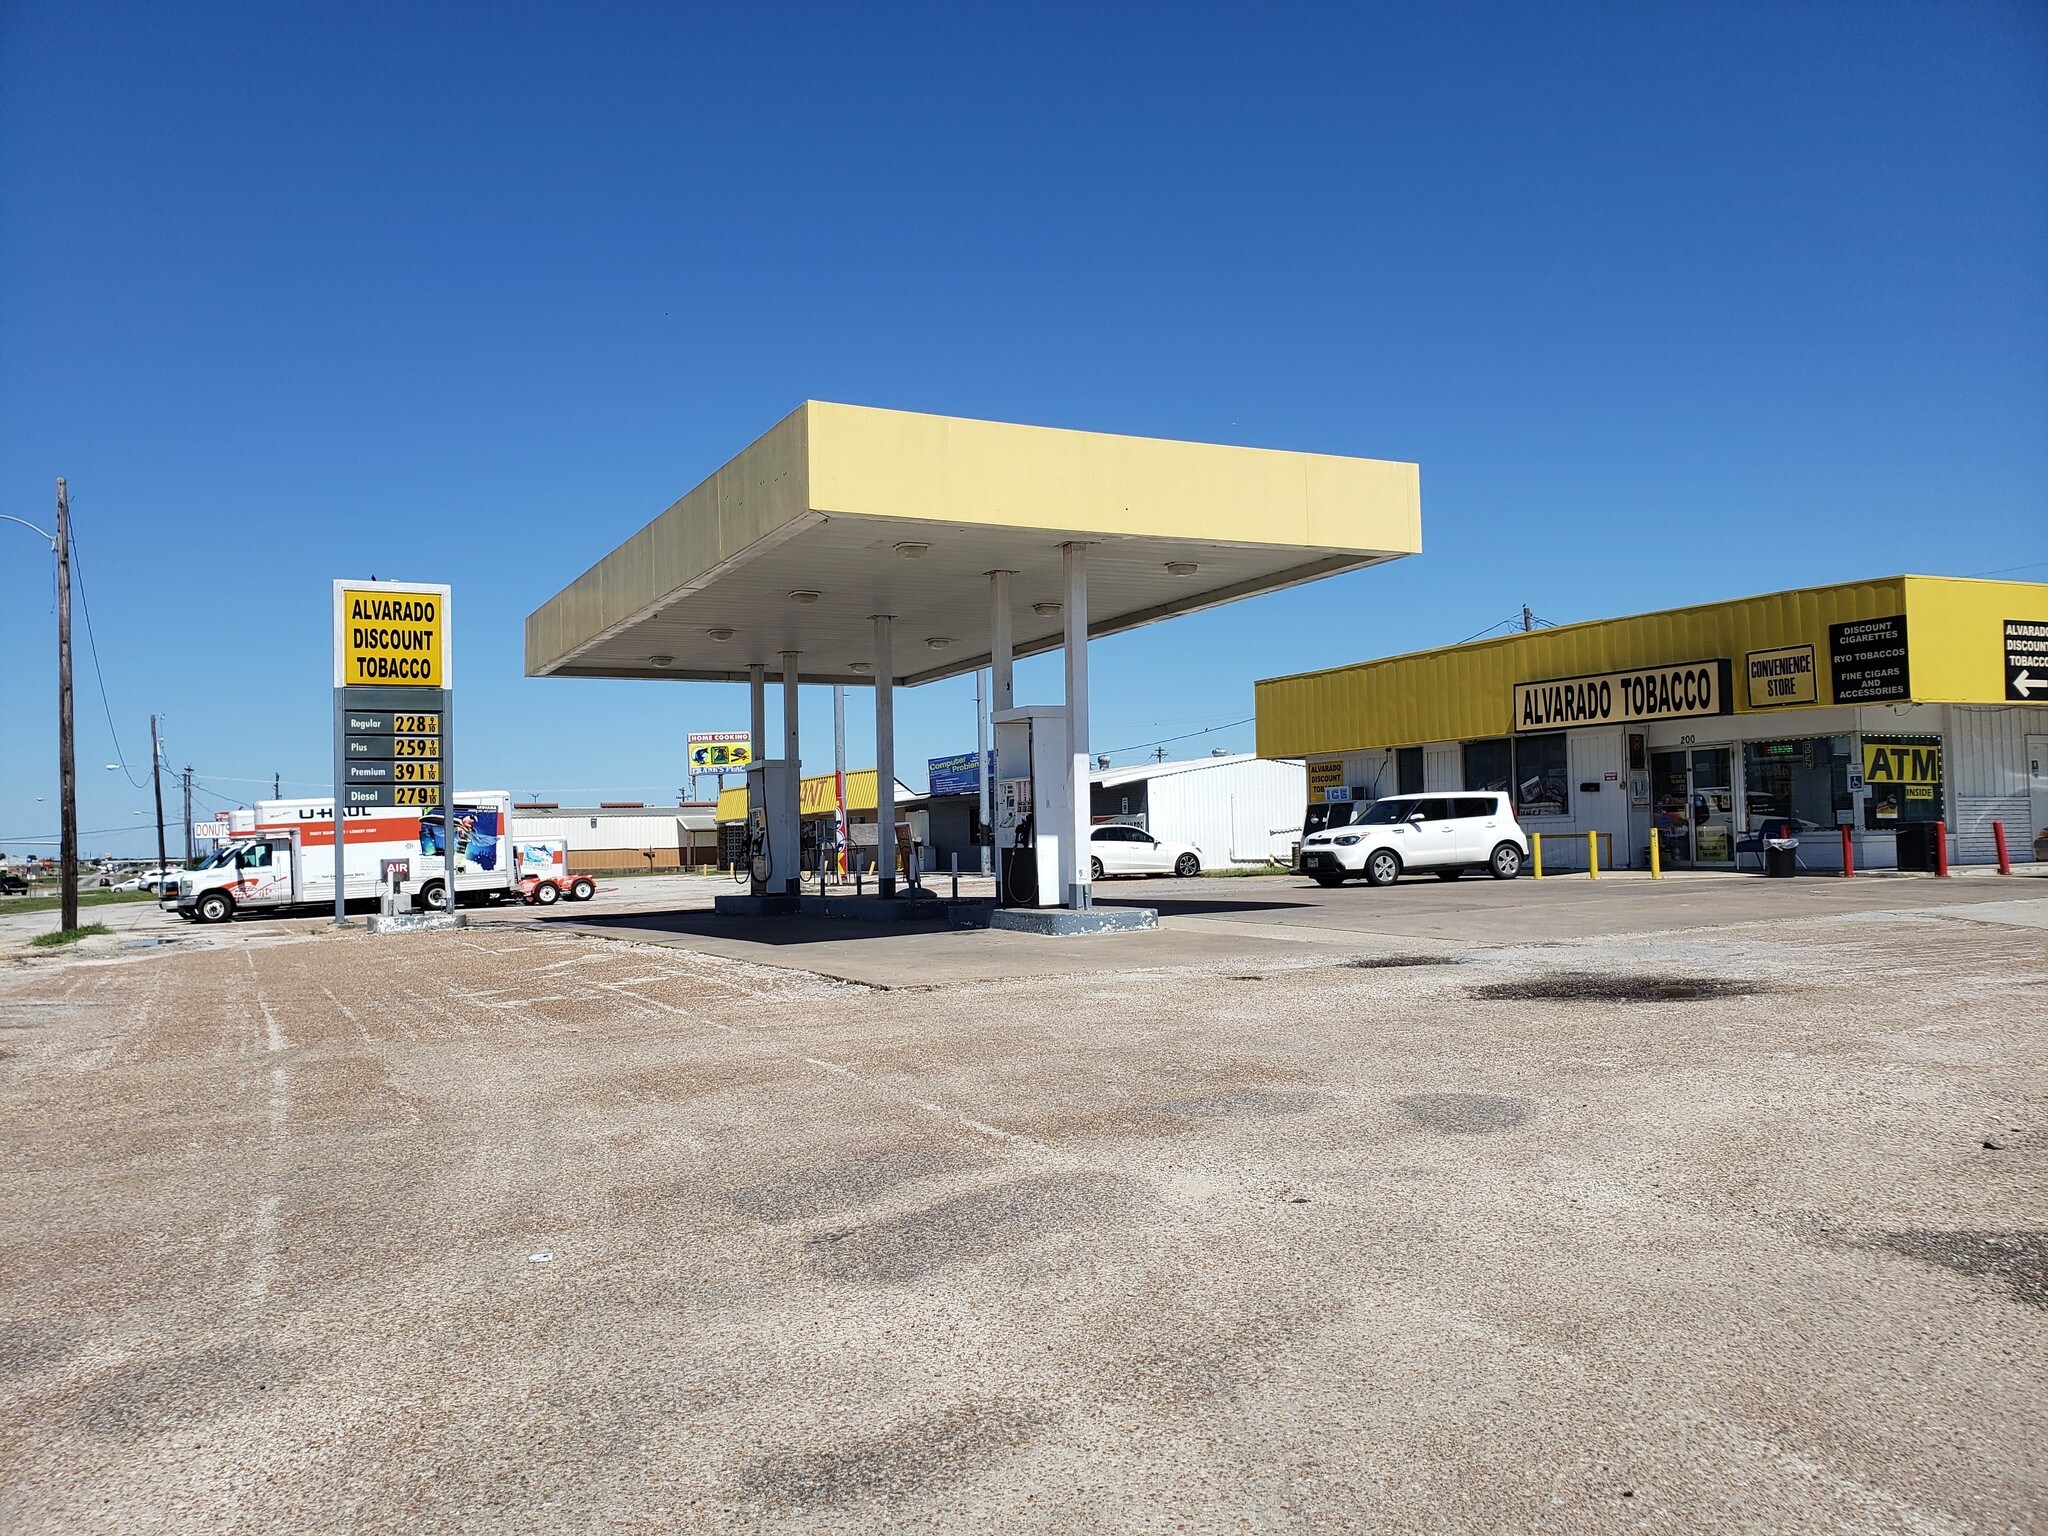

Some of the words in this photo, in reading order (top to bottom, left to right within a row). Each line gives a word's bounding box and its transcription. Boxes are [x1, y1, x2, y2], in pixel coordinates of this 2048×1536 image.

[352, 599, 435, 622] ALVARADO
[1844, 622, 1892, 635] DISCOUNT
[353, 628, 433, 650] DISCOUNT
[1840, 631, 1898, 645] CIGARETTES
[1834, 654, 1852, 664] RYO
[1855, 649, 1906, 661] TOBACCOS
[2009, 656, 2048, 667] TOBACCO
[357, 657, 431, 679] TOBACCO
[1751, 654, 1811, 679] CONVENIENCE
[1841, 672, 1862, 681] FINE
[1864, 667, 1900, 679] CIGARS
[1768, 677, 1796, 697] STORE
[1861, 679, 1881, 688] AND
[1523, 680, 1611, 725] ALVARADO
[1620, 668, 1711, 716] TOBACCO
[1839, 686, 1904, 699] ACCESSORIES
[351, 719, 381, 730] Regular
[395, 716, 426, 732] 228
[1680, 735, 1695, 744] 200
[351, 743, 368, 752] Plus
[396, 740, 426, 756] 259
[929, 757, 966, 771] Computer
[1311, 764, 1342, 773] ALVARADO
[1867, 748, 1937, 780] ATM
[351, 767, 386, 776] Premium
[395, 763, 424, 780] 391
[1311, 774, 1341, 783] DISCOUNT
[351, 790, 378, 801] Diesel
[396, 788, 428, 804] 279
[1326, 789, 1348, 800] ICE
[1906, 788, 1932, 797] INSIDE
[299, 806, 372, 819] U-HUL
[387, 863, 408, 872] AIR
